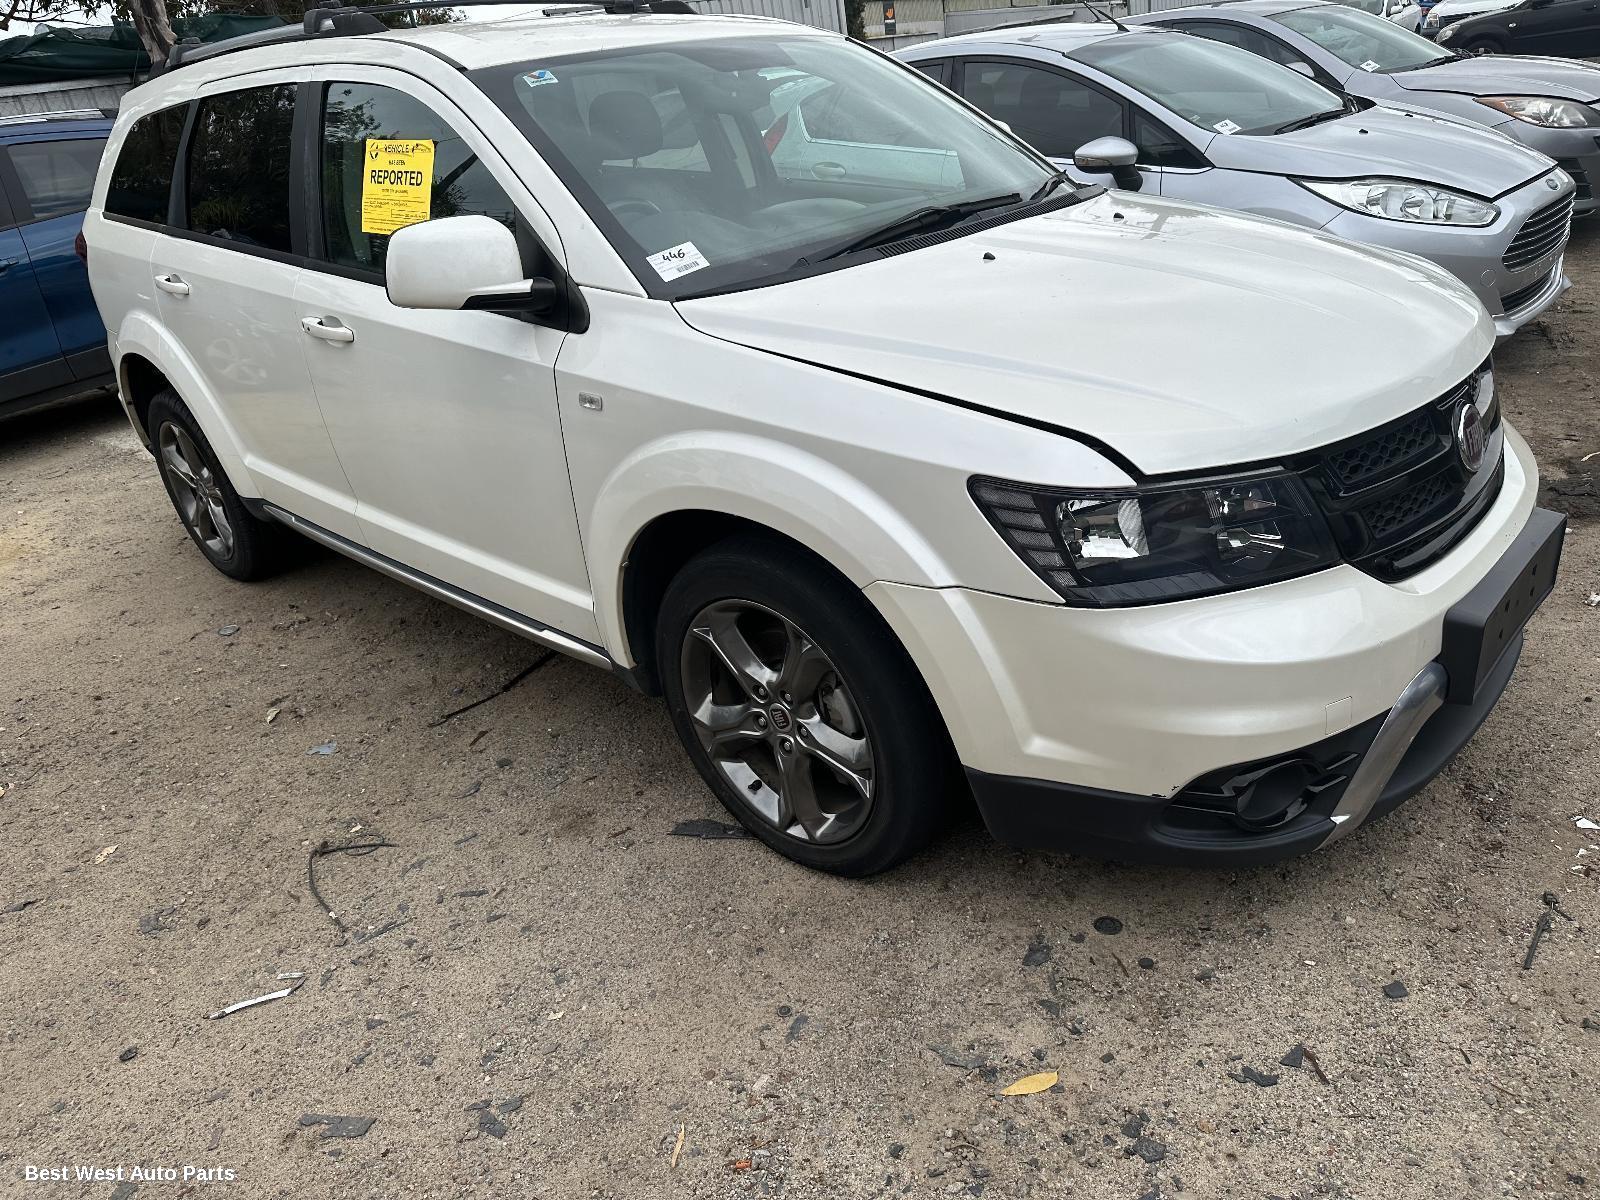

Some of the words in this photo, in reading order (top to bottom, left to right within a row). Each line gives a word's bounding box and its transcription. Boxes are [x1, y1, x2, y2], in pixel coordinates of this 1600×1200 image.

[384, 144, 410, 154] VEHICLE
[370, 169, 423, 187] REPORTED
[662, 248, 686, 262] 446
[771, 710, 788, 728] FIAT
